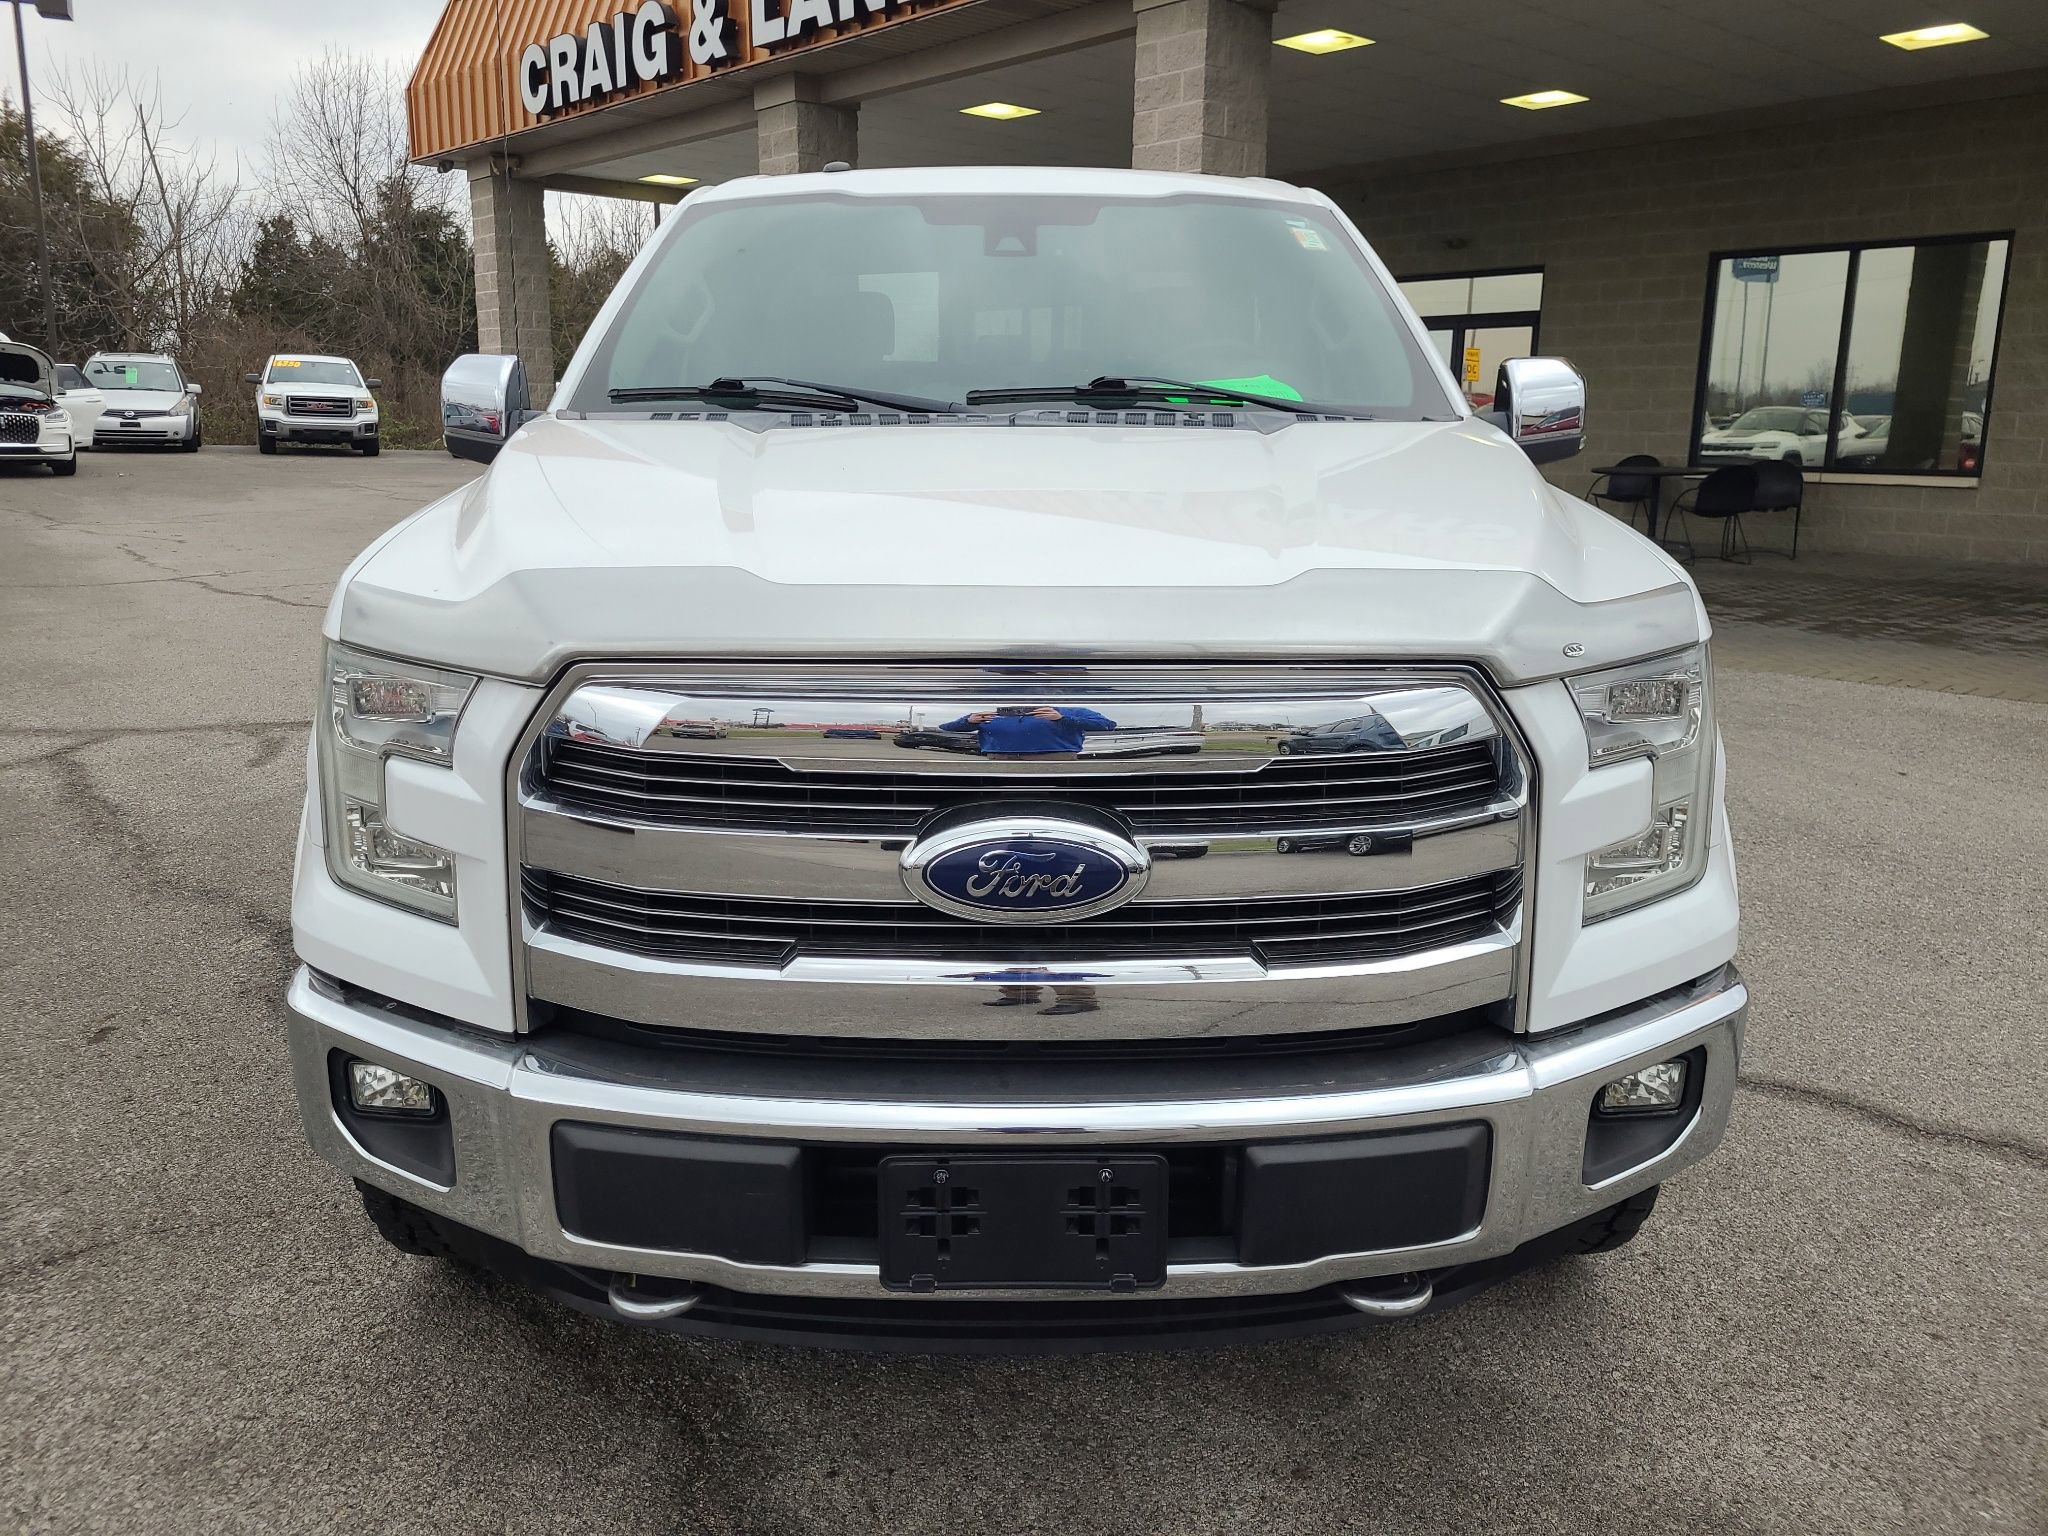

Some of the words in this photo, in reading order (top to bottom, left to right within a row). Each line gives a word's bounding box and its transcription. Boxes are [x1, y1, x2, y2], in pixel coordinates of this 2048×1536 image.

[520, 0, 668, 114] CRAIG
[689, 0, 727, 65] &
[966, 850, 1085, 898] Ford
